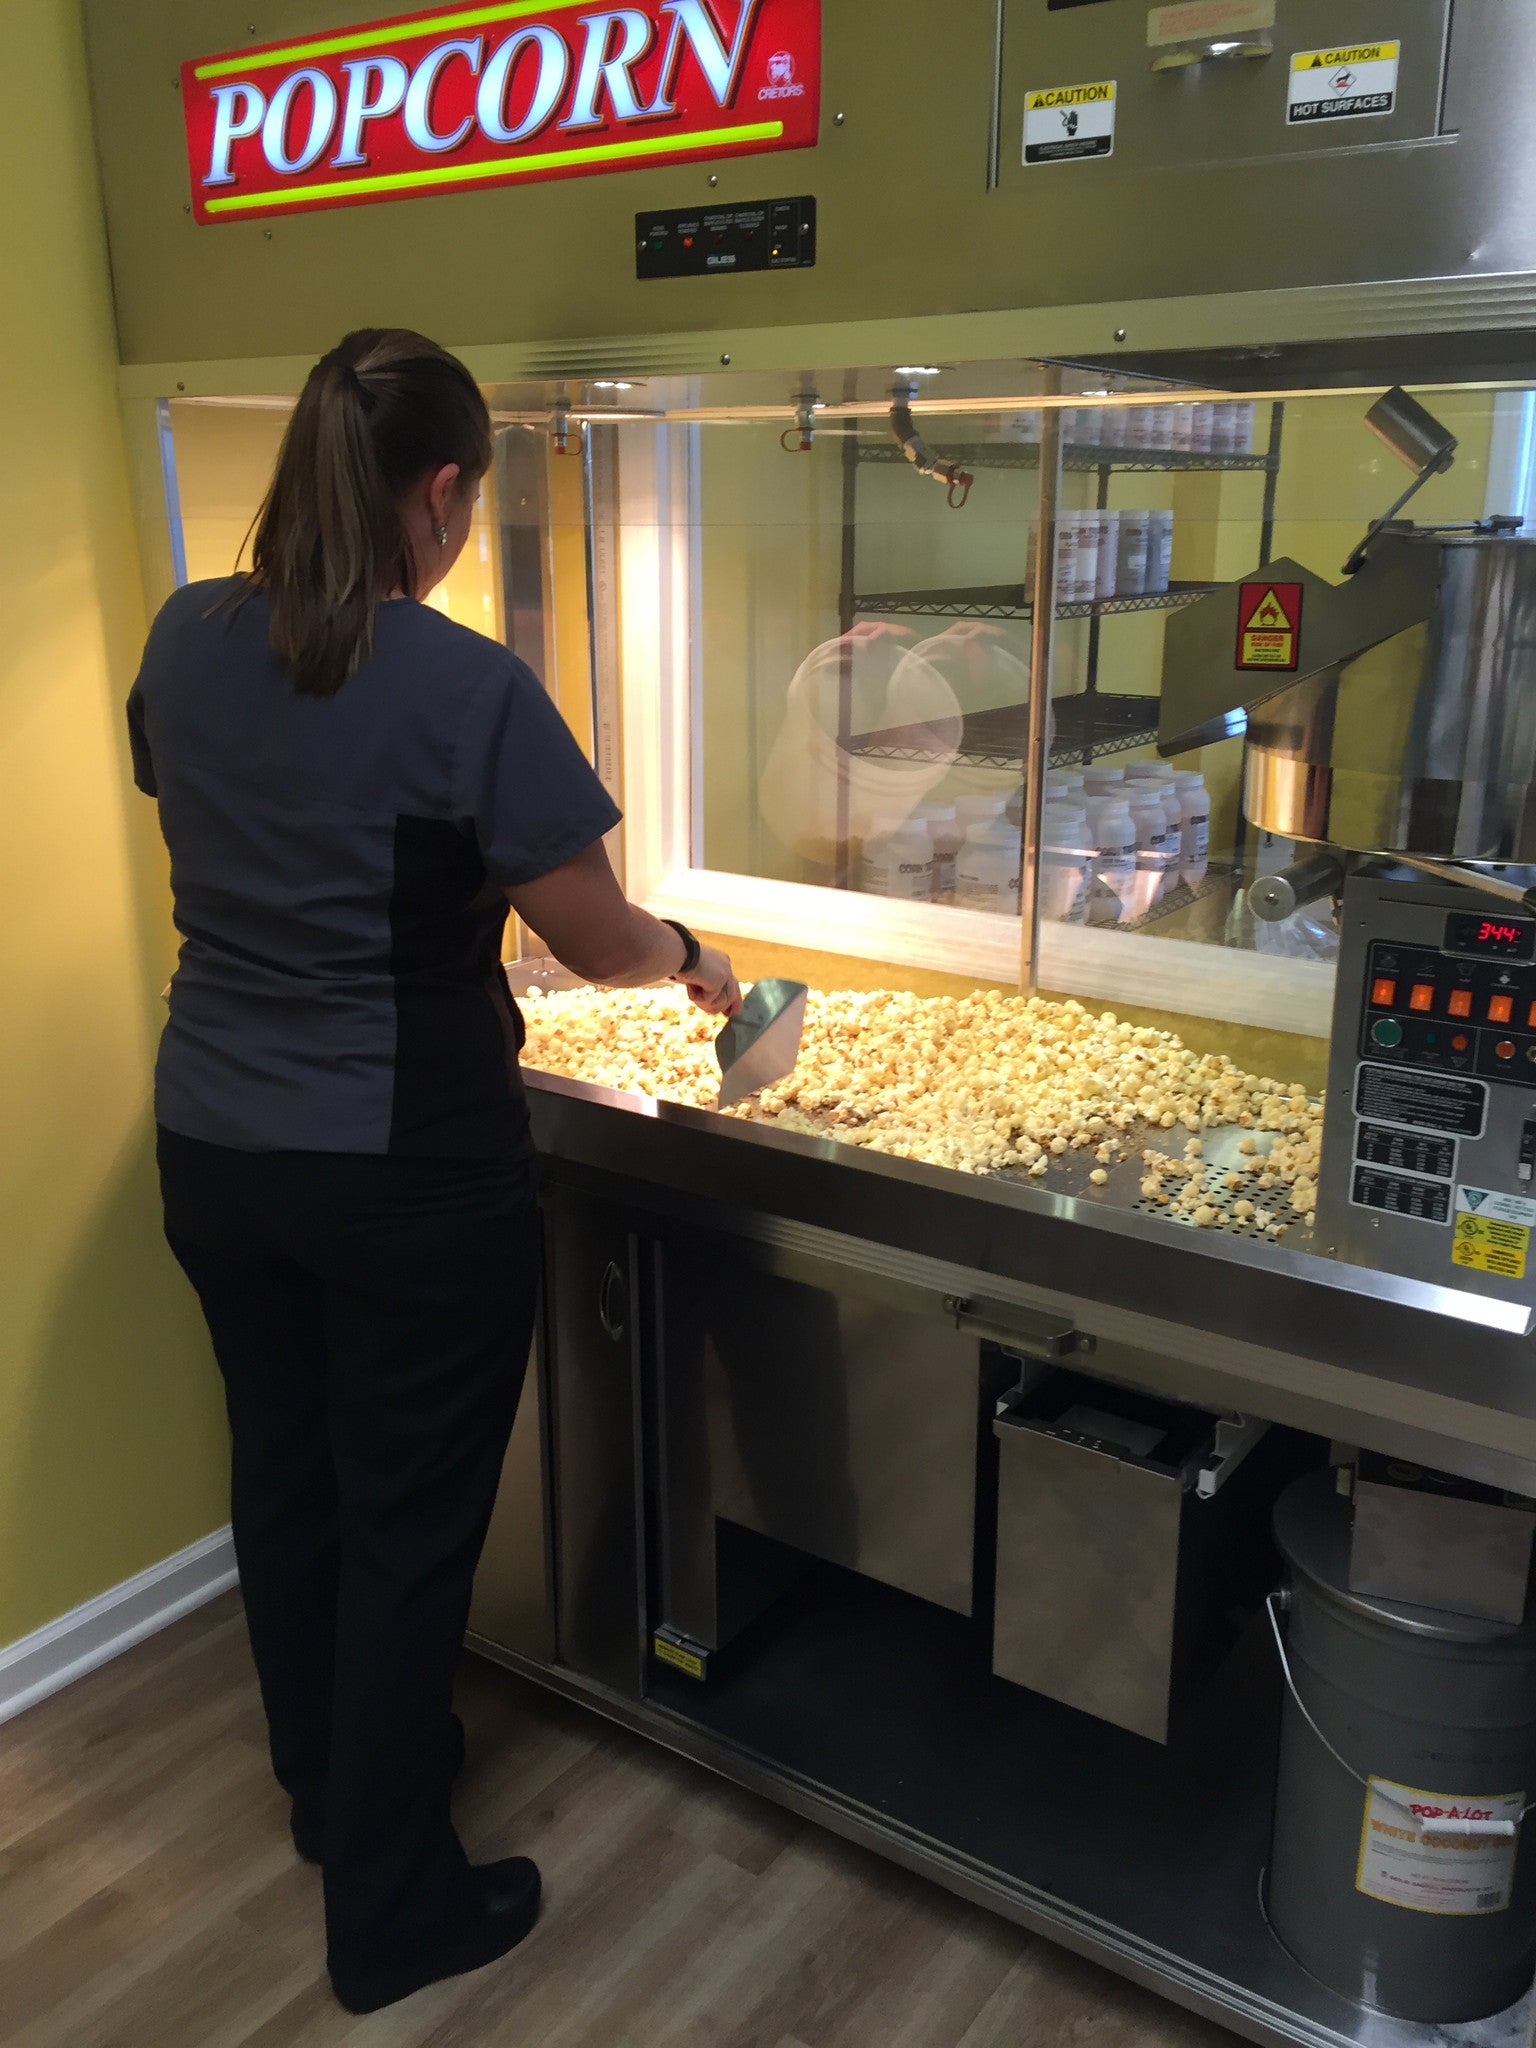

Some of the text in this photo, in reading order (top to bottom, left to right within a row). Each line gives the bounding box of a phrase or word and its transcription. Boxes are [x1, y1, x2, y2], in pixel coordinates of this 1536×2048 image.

[1324, 47, 1380, 65] CAUTION
[201, 0, 758, 186] POPCORN
[757, 84, 805, 101] CRETORS
[1045, 85, 1108, 106] CAUTION
[1293, 94, 1389, 117] HOT SURFACES
[1477, 921, 1516, 943] 344
[1410, 1804, 1494, 1820] POP-A-LOT
